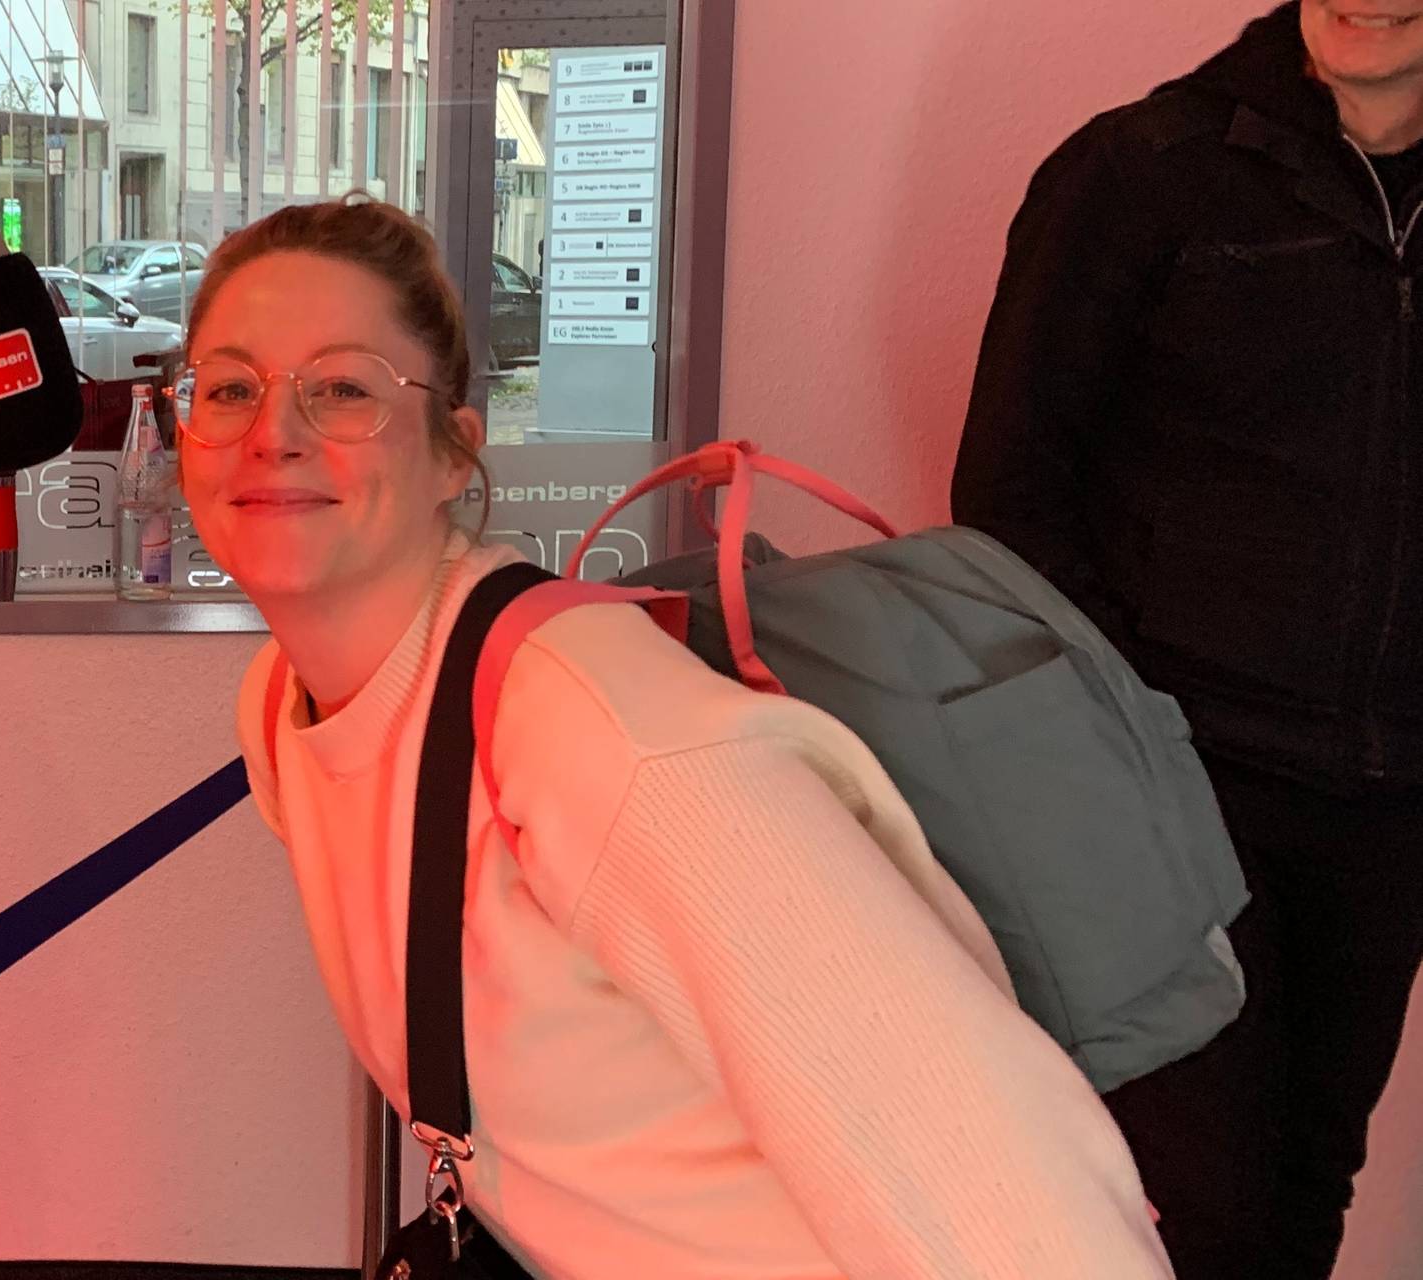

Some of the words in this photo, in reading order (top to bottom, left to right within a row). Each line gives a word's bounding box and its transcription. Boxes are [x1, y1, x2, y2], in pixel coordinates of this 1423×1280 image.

[565, 65, 572, 76] 9
[564, 95, 570, 106] 8
[564, 124, 570, 135] 7
[562, 153, 569, 164] 6
[562, 182, 568, 193] 5
[561, 212, 567, 222] 4
[560, 240, 566, 251] 3
[559, 270, 565, 281] 2
[558, 298, 563, 309] 1
[553, 327, 567, 338] EG
[464, 481, 627, 505] ppenberg
